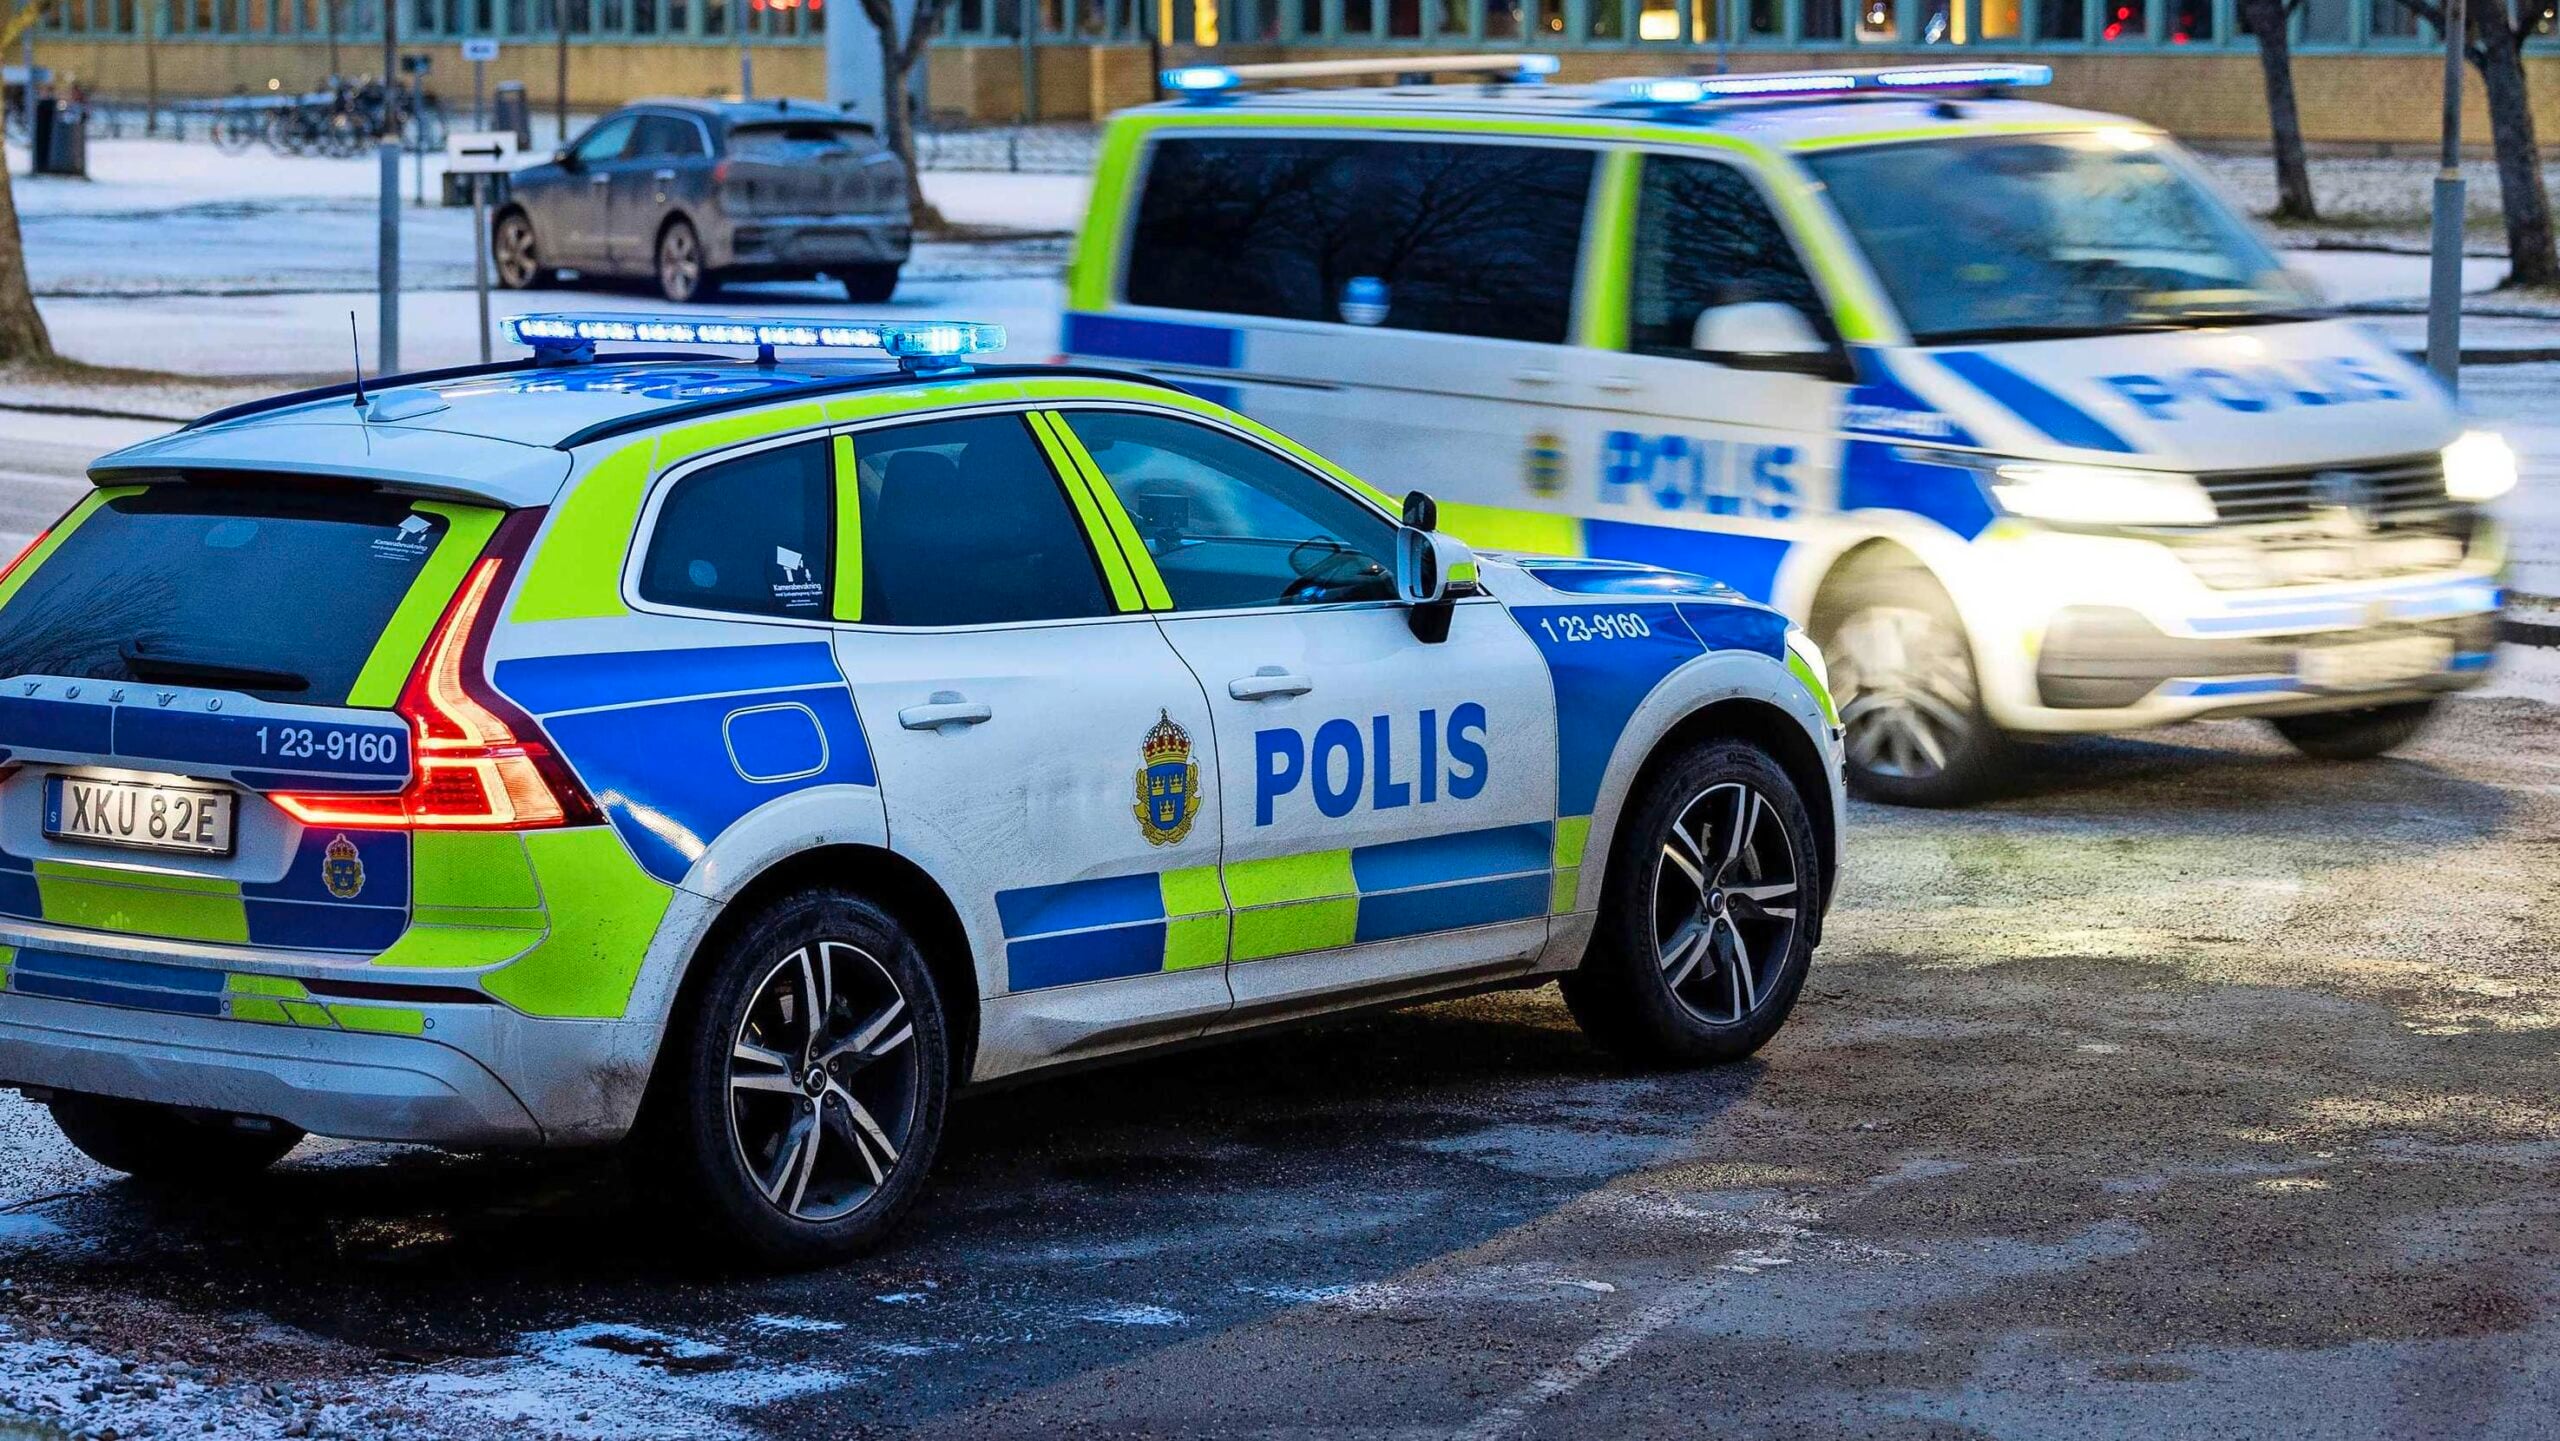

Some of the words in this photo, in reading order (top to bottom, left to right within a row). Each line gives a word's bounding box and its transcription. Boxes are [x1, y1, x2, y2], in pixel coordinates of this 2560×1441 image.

[2102, 356, 2407, 420] POLIS
[1599, 429, 1801, 519] POLIS
[773, 582, 821, 591] Kamerabevakning
[1541, 617, 1559, 642] 1
[1559, 613, 1650, 642] 23-9160
[24, 682, 223, 712] VOLVO
[256, 726, 268, 755] 1
[279, 727, 397, 764] 23-9160
[1254, 701, 1489, 827] POLIS
[50, 811, 57, 823] S
[71, 785, 136, 836] XKU
[149, 794, 217, 843] 82E
